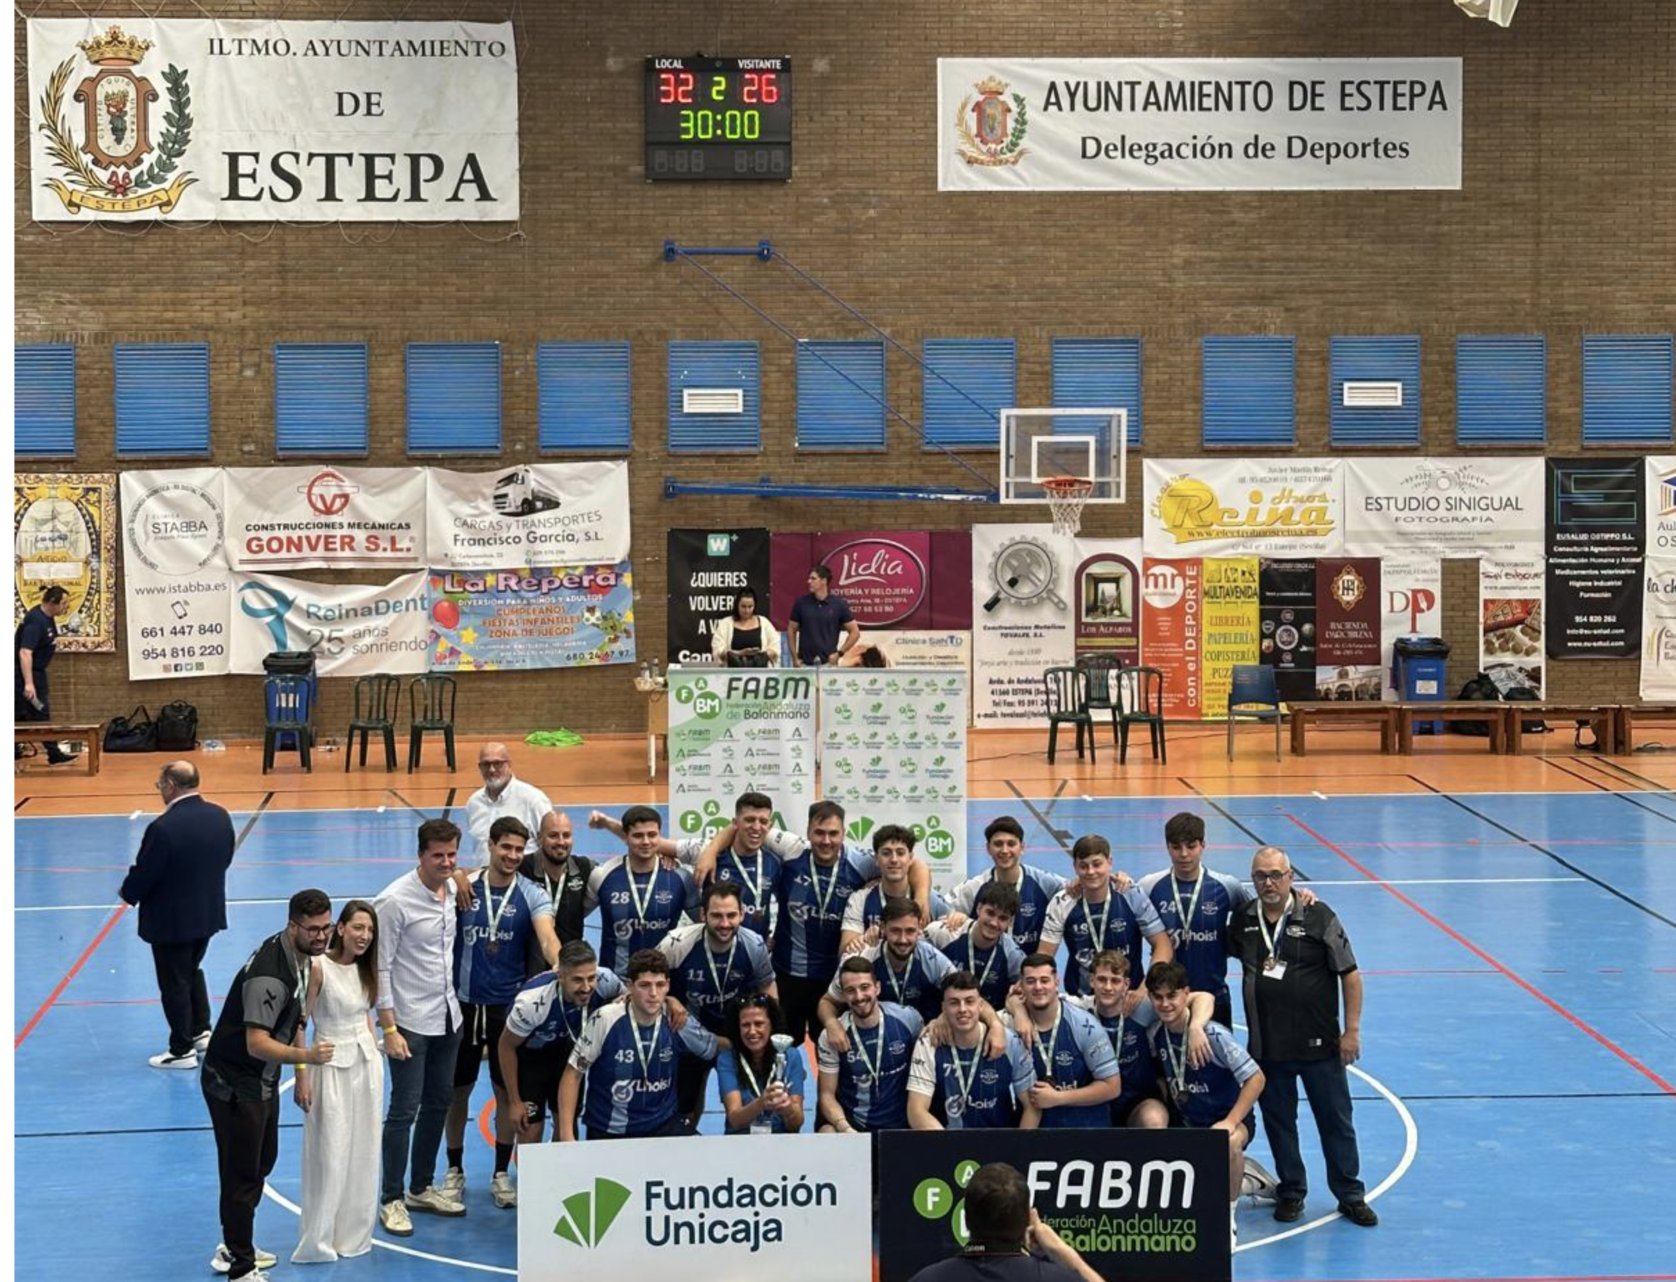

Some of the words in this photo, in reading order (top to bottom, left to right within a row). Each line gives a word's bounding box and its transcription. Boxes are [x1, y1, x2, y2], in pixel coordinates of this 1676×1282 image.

[208, 38, 297, 58] ILTMO.
[303, 38, 507, 59] AYUNTAMIENTO
[655, 59, 684, 69] LOCAL
[738, 59, 782, 69] VISITANTE
[660, 73, 693, 103] 32
[711, 76, 726, 100] 2
[743, 73, 778, 103] 26
[1042, 80, 1274, 113] AYUNTAMIENTO
[1288, 80, 1326, 112] DE
[1340, 79, 1448, 112] ESTEPA
[334, 91, 385, 118] DE
[680, 110, 760, 139] 30:00
[1080, 135, 1230, 166] Delegación
[1243, 137, 1276, 160] de
[1286, 135, 1410, 166] Deportes
[221, 150, 499, 203] ESTEPA
[79, 192, 163, 212] ESTEPA
[1365, 496, 1440, 512] ESTUDIO
[1445, 496, 1523, 512] SINIGUAL
[245, 522, 344, 532] CONSTRUCCIONES
[453, 517, 503, 531] CARGAS
[506, 522, 512, 531] y
[516, 511, 602, 530] TRANSPORTES
[1394, 515, 1494, 523] FOTOGRAFÍA
[246, 534, 355, 554] GONVER
[365, 534, 412, 553] S.L.
[453, 533, 522, 547] Francisco
[526, 530, 580, 545] García,
[585, 532, 604, 542] S.L.
[1556, 533, 1589, 541] EUSALUD
[838, 549, 903, 585] Lidia
[443, 573, 487, 594] La
[496, 571, 618, 595] Repera
[690, 571, 748, 588] ¿QUIERES
[135, 581, 227, 596] www.istabba.es
[871, 587, 914, 595] RELOJERÍA
[1203, 585, 1258, 600] MULTIAVENIDA
[306, 594, 427, 622] ReinaDent
[689, 595, 735, 611] VOLVER
[1185, 565, 1197, 650] DEPORTE
[698, 618, 707, 634] A
[1209, 614, 1252, 627] LIBRERÍA
[141, 626, 165, 639] 661
[169, 624, 194, 637] 447
[198, 623, 223, 636] 840
[352, 626, 389, 640] años
[1207, 630, 1256, 645] PAPELERÍA
[307, 628, 345, 656] 25
[352, 638, 429, 655] sonriendo
[142, 647, 166, 660] 954
[171, 645, 196, 658] 816
[199, 644, 224, 657] 220
[1204, 648, 1257, 662] COPISTERÍA
[1185, 656, 1196, 672] el
[726, 676, 811, 700] FABM
[1187, 679, 1196, 708] con
[696, 698, 719, 713] BM
[726, 710, 742, 720] de
[744, 709, 811, 720] Balonmano
[927, 837, 951, 853] BM
[720, 868, 730, 880] 9
[610, 891, 630, 904] 28
[1160, 901, 1176, 914] 24
[687, 969, 706, 982] 11
[614, 1049, 635, 1063] 43
[646, 1175, 837, 1211] Fundación
[1028, 1160, 1195, 1209] FABM
[926, 1187, 941, 1211] F
[646, 1211, 783, 1252] Unicaja
[1041, 1214, 1096, 1229] deración
[1098, 1214, 1197, 1235] Andaluza
[1061, 1231, 1196, 1253] Balonmano
